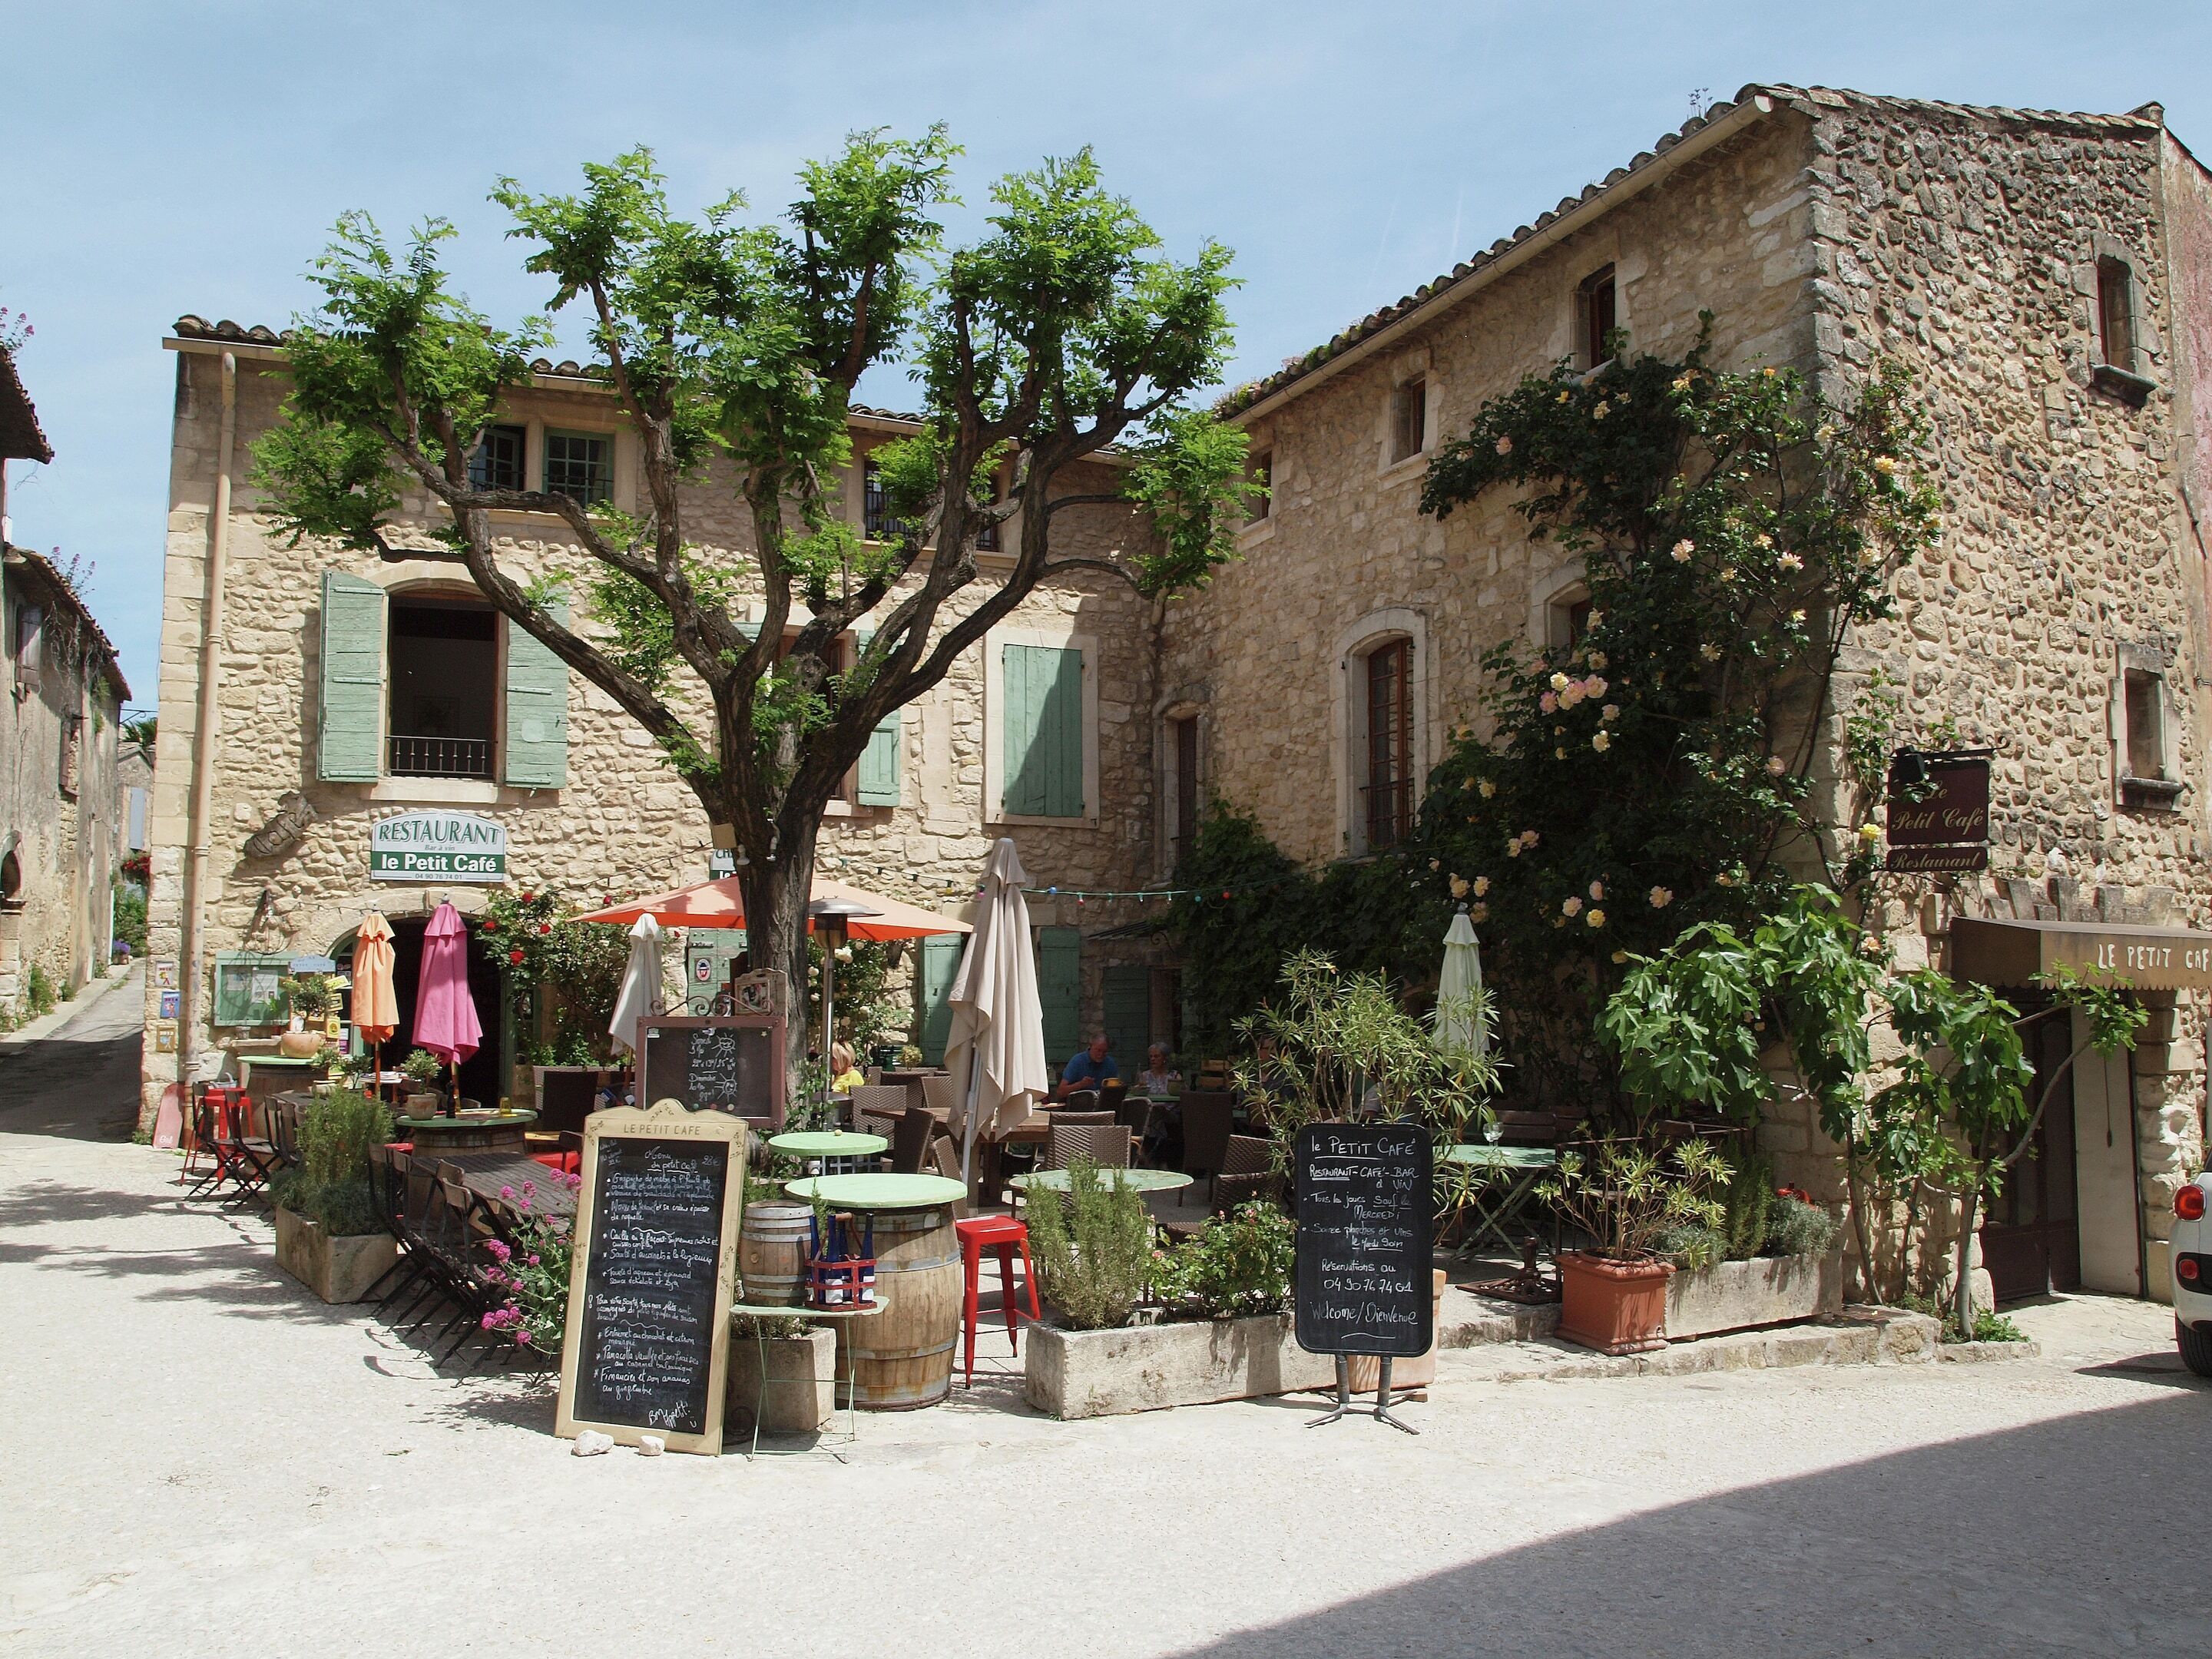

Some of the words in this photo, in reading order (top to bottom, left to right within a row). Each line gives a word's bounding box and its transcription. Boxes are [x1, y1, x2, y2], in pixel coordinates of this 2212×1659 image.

[1924, 780, 1947, 800] Le
[1892, 811, 1936, 830] Petit
[1942, 807, 1984, 835] Café
[379, 820, 501, 845] RESTAURANT
[382, 854, 399, 869] le
[405, 853, 448, 871] Petit
[454, 855, 496, 873] Café
[1891, 852, 1980, 869] Restaurant
[2098, 944, 2115, 969] LE
[2127, 945, 2171, 970] PETIT
[2186, 948, 2212, 972] CAF
[624, 1124, 636, 1134] LE
[639, 1124, 670, 1134] PETIT
[674, 1125, 701, 1135] CAFE
[644, 1145, 671, 1159] Menu
[1311, 1135, 1321, 1152] le
[662, 1159, 680, 1177] petit
[1321, 1258, 1376, 1272] Réservations
[1380, 1264, 1396, 1273] au
[1323, 1277, 1341, 1292] 04
[1344, 1277, 1361, 1291] 90
[1363, 1278, 1376, 1292] 76
[1379, 1279, 1392, 1293] 74
[1395, 1281, 1414, 1293] 01
